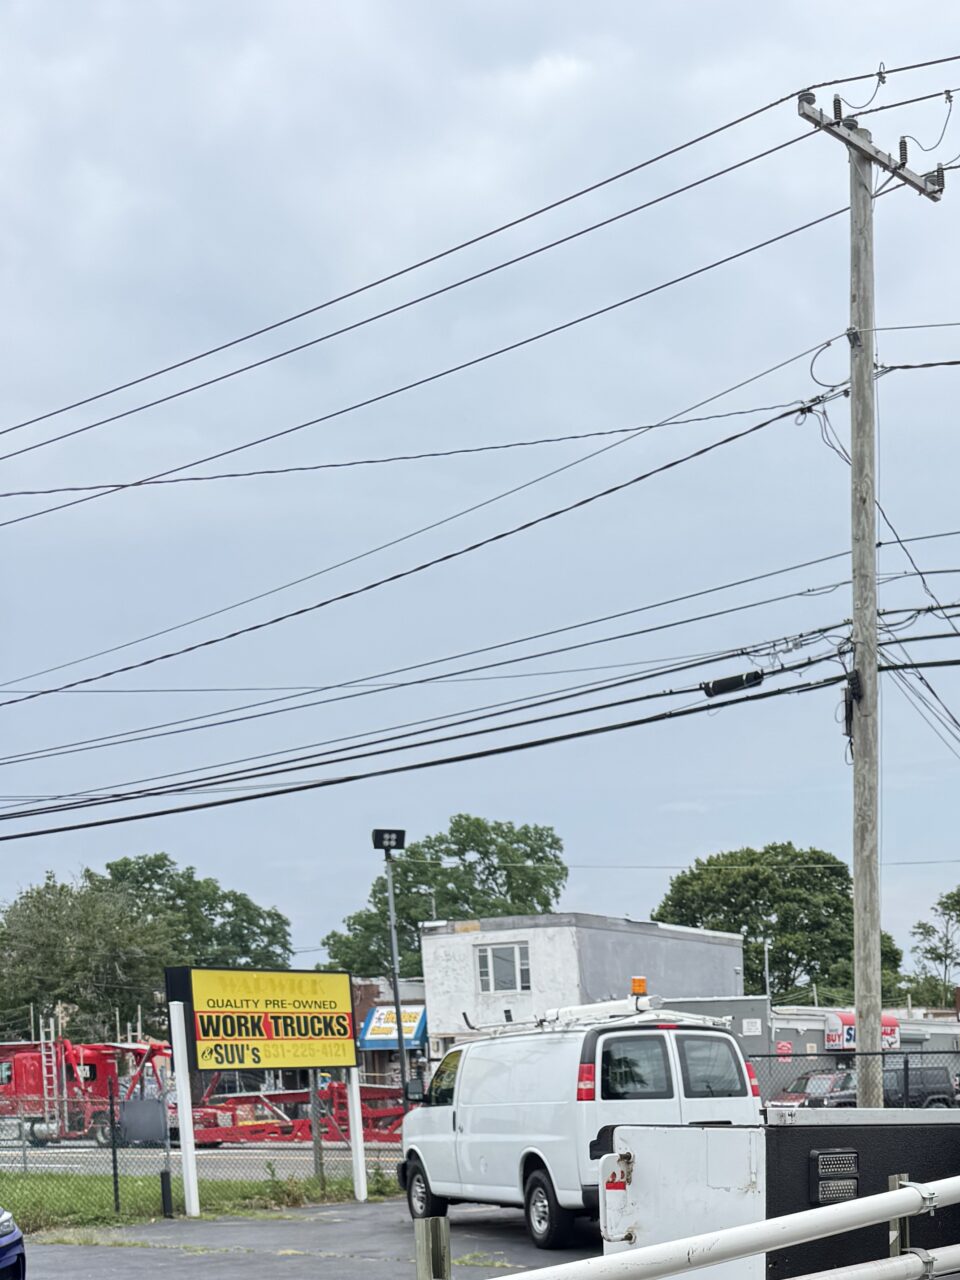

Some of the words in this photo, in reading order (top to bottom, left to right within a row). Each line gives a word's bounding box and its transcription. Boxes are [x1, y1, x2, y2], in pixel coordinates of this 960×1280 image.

[206, 998, 260, 1009] QUALITY
[264, 998, 338, 1010] PRE-OWNED
[198, 1014, 265, 1038] WORK
[270, 1014, 349, 1037] TRUCKS
[826, 1033, 843, 1043] BUY
[213, 1043, 261, 1065] SUV's
